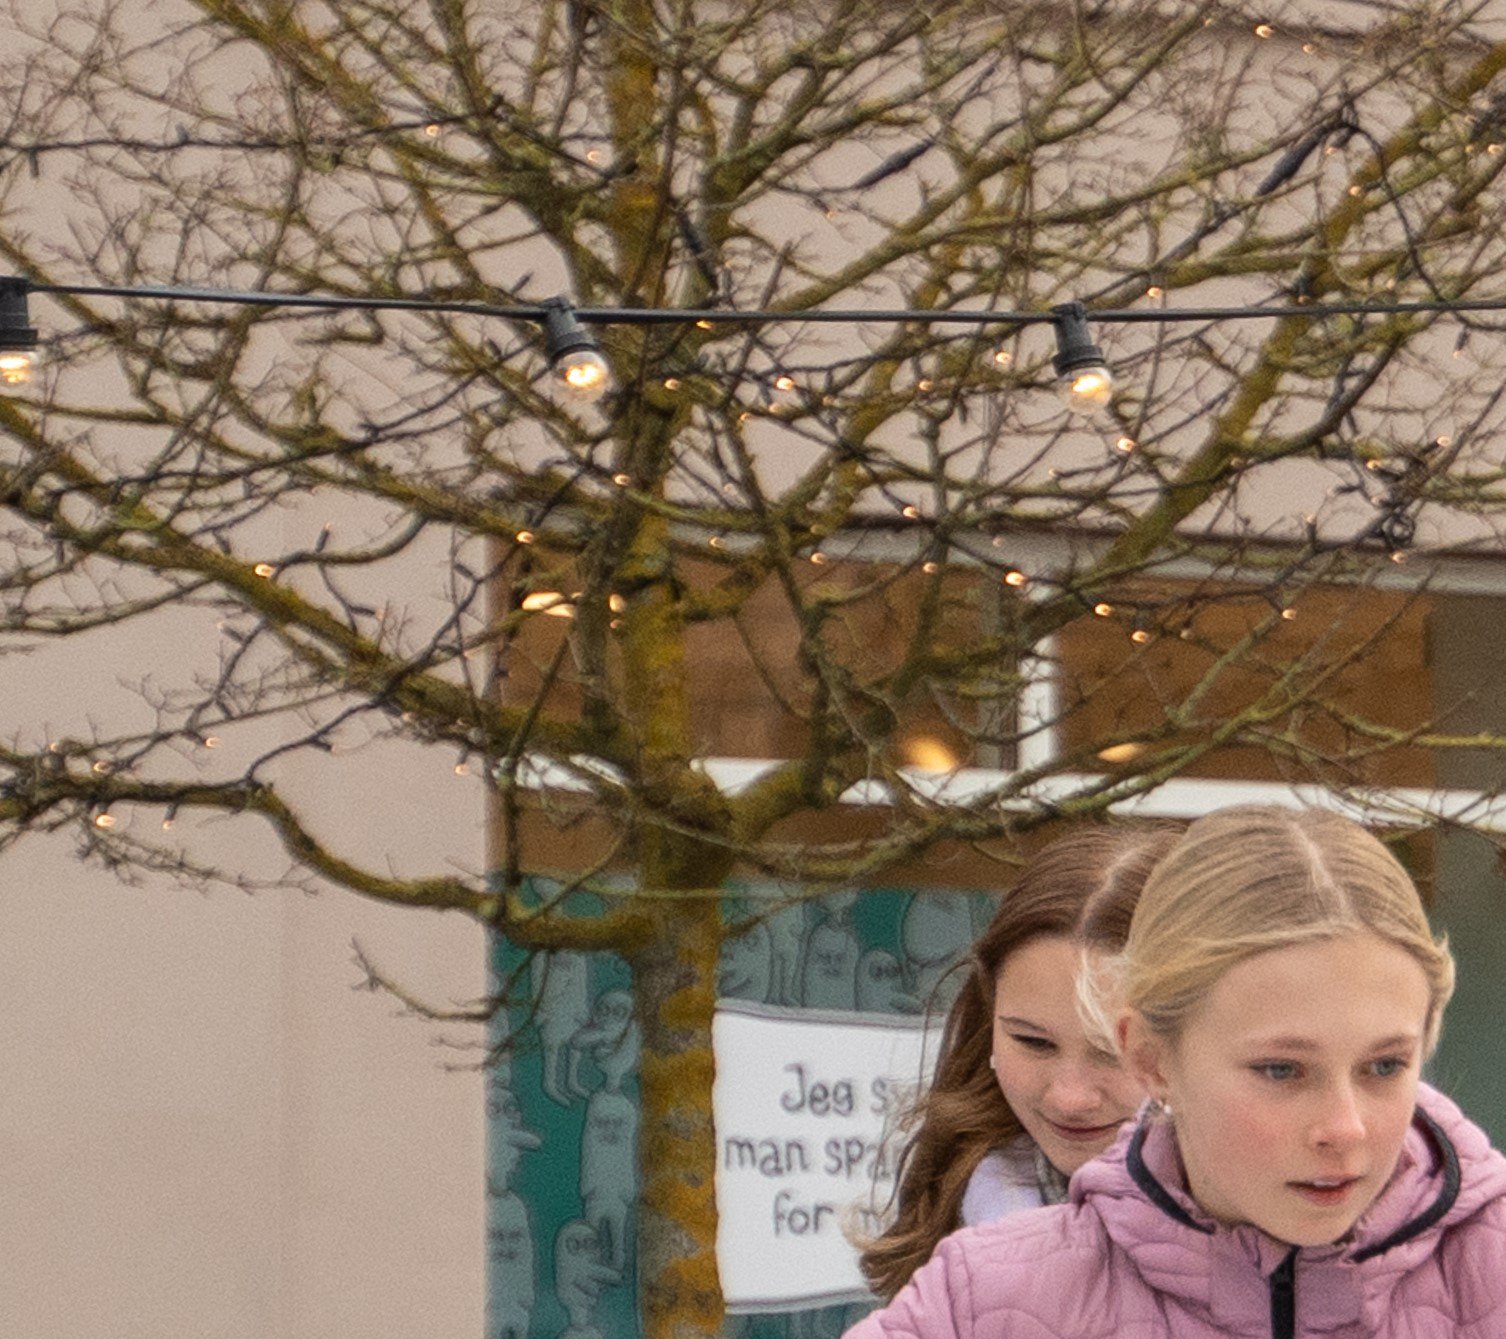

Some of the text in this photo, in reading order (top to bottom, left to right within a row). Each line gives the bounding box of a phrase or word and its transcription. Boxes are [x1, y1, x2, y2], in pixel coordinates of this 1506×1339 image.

[780, 1062, 855, 1116] Jeg
[724, 1136, 808, 1178] man
[773, 1189, 835, 1237] for
